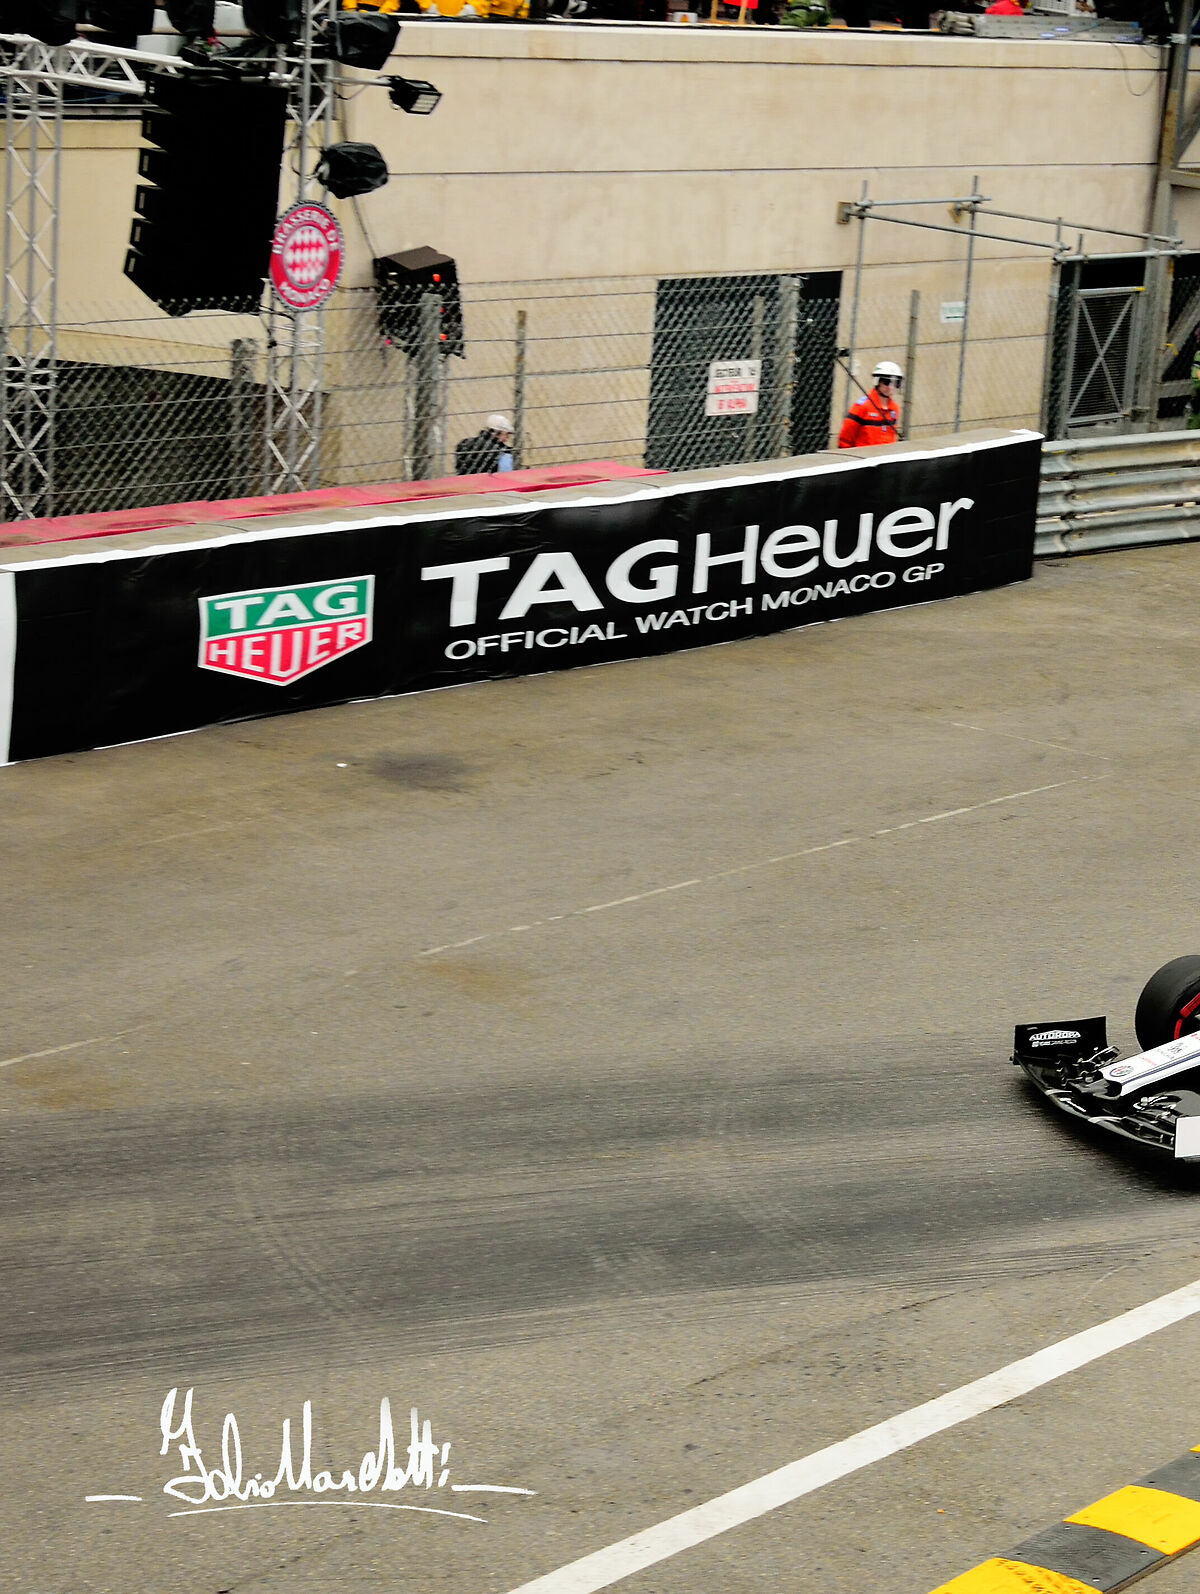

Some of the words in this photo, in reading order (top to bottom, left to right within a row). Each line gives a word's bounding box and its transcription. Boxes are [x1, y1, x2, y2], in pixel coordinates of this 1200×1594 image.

[421, 539, 679, 628] TAG
[692, 497, 975, 594] Heuer
[214, 584, 360, 630] TAG
[444, 621, 628, 660] OFFICIAL
[635, 598, 753, 634] WATCH
[761, 571, 896, 611] MONACO
[902, 563, 945, 585] GP
[208, 622, 364, 678] HEUER
